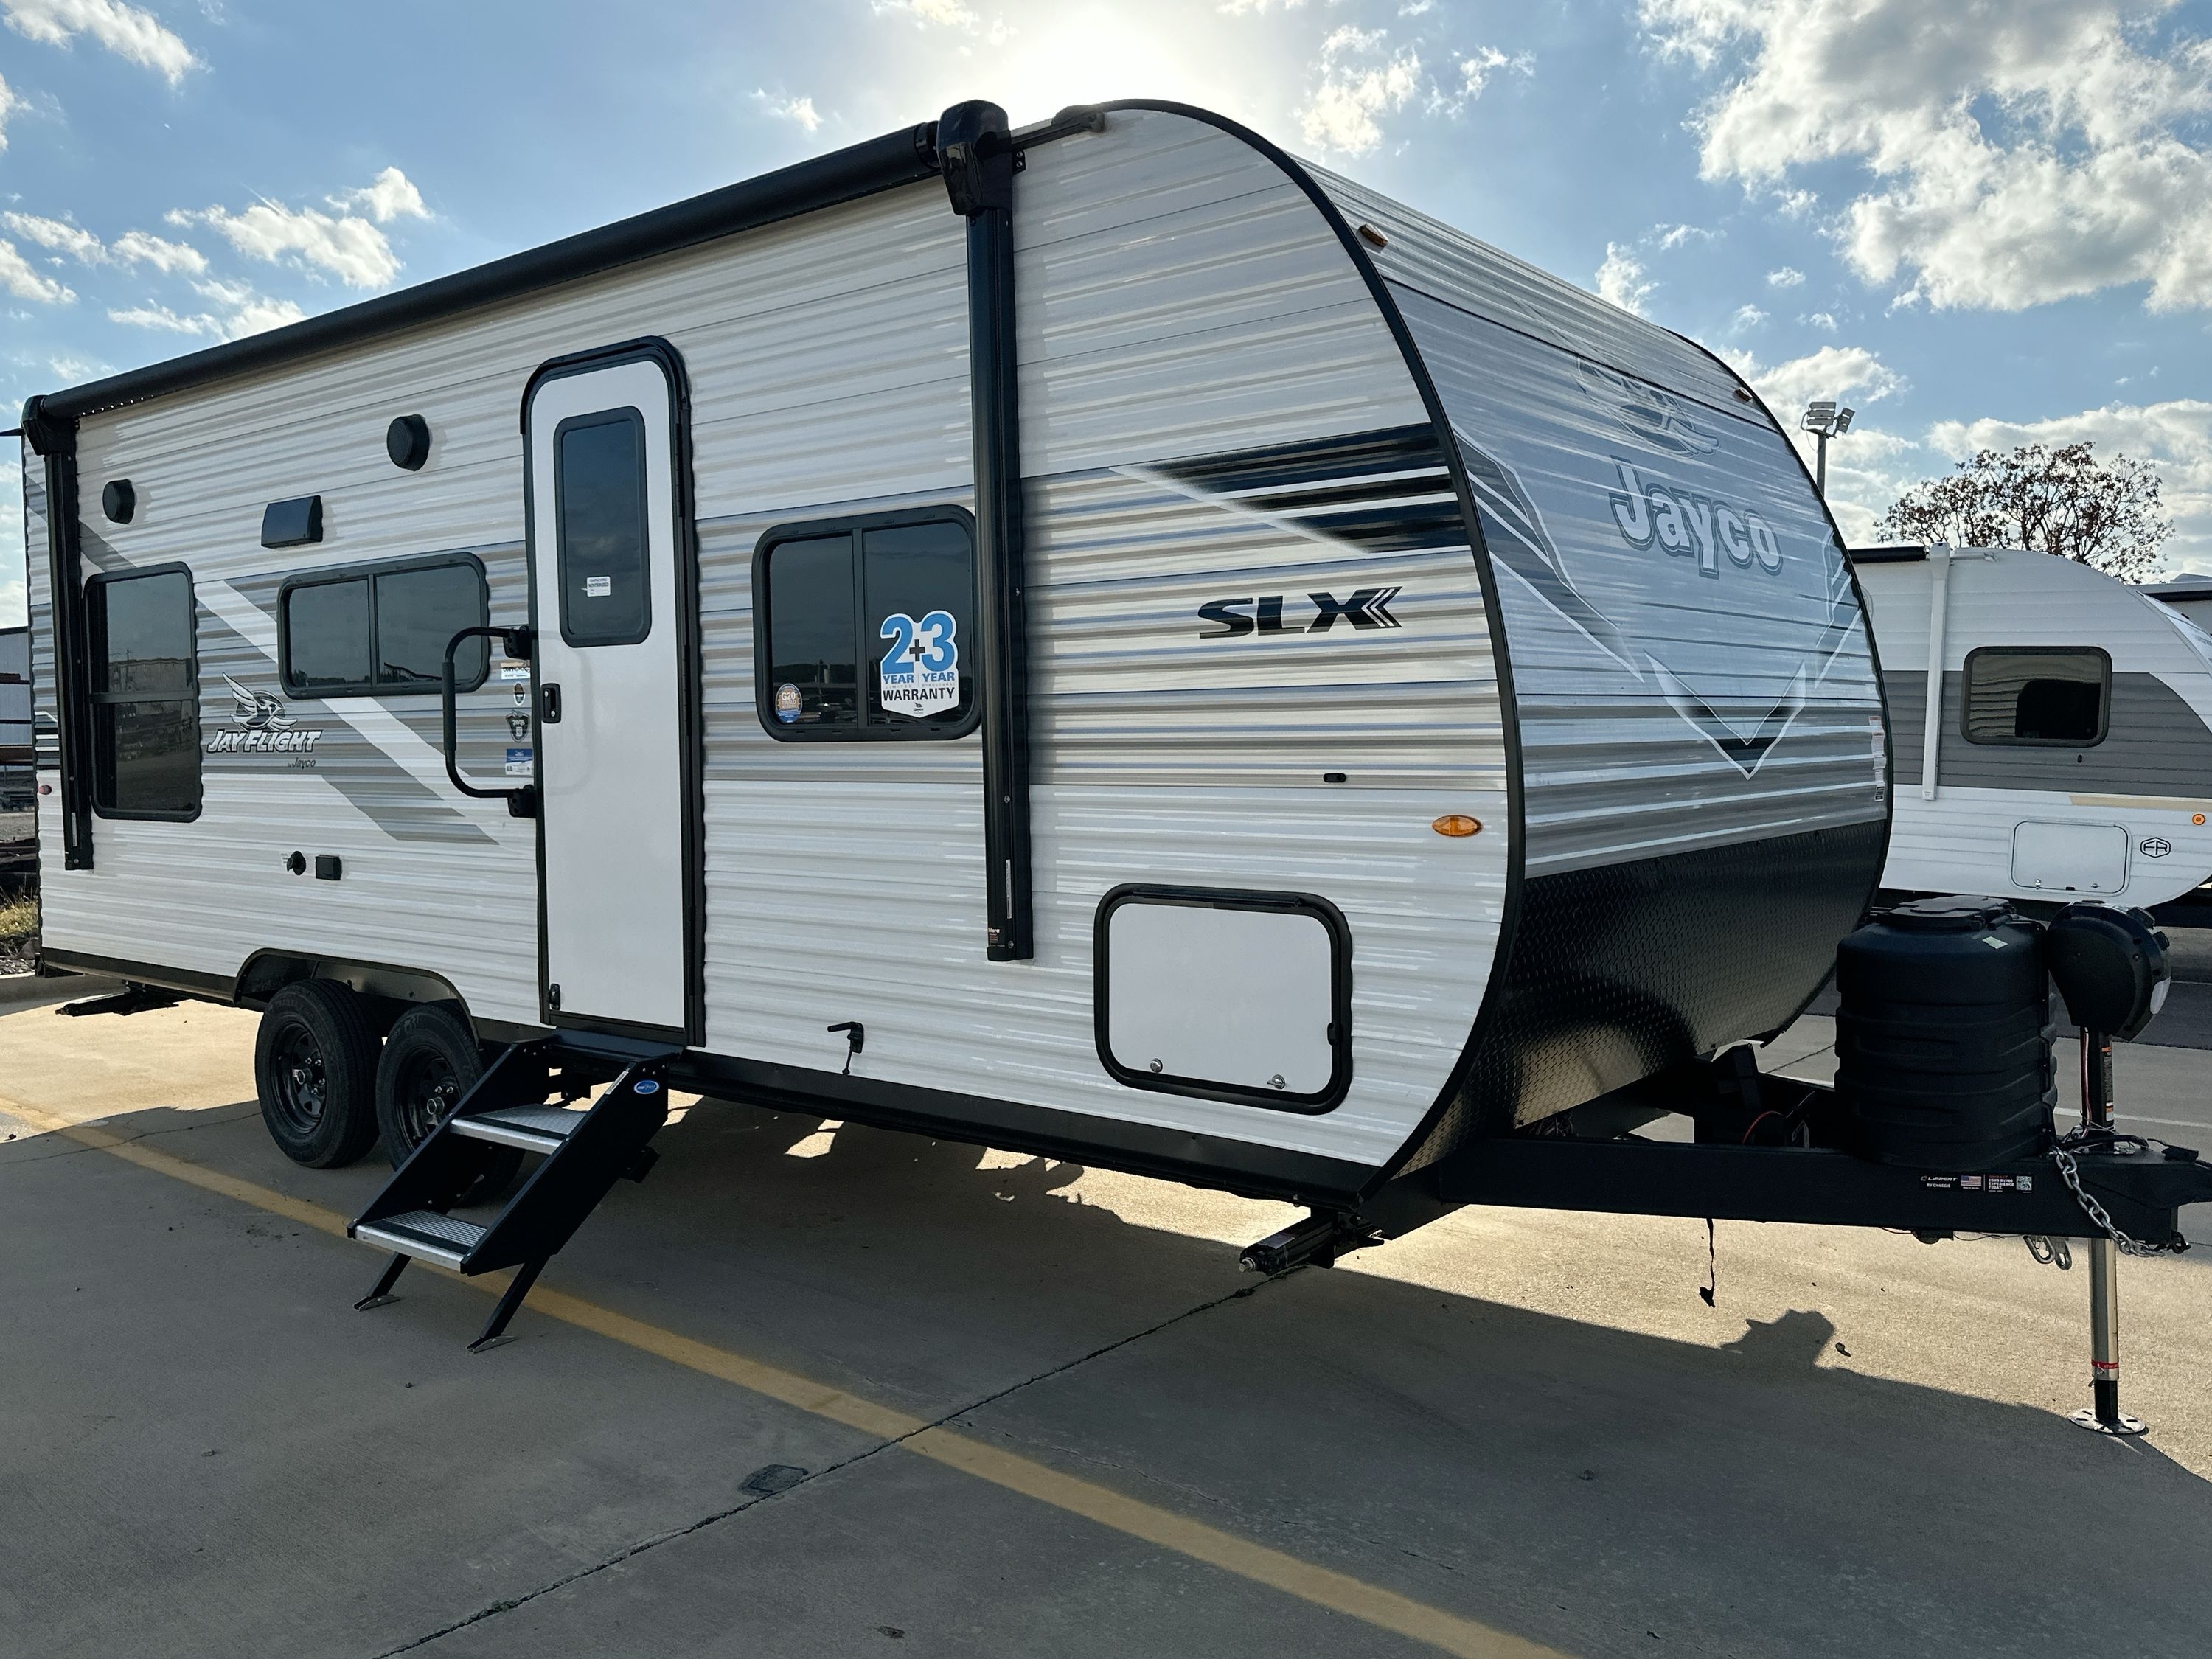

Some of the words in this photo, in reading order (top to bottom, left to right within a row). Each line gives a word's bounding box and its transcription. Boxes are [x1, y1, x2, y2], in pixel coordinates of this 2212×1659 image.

[1608, 454, 1784, 580] Jayco
[1197, 586, 1403, 639] SLX
[883, 674, 914, 684] YEAR
[922, 672, 955, 683] YEAR
[782, 692, 796, 700] G20
[883, 687, 955, 701] WARRANTY
[206, 728, 248, 753] JAY
[243, 728, 324, 753] FLIGHT
[295, 757, 316, 770] Jayco
